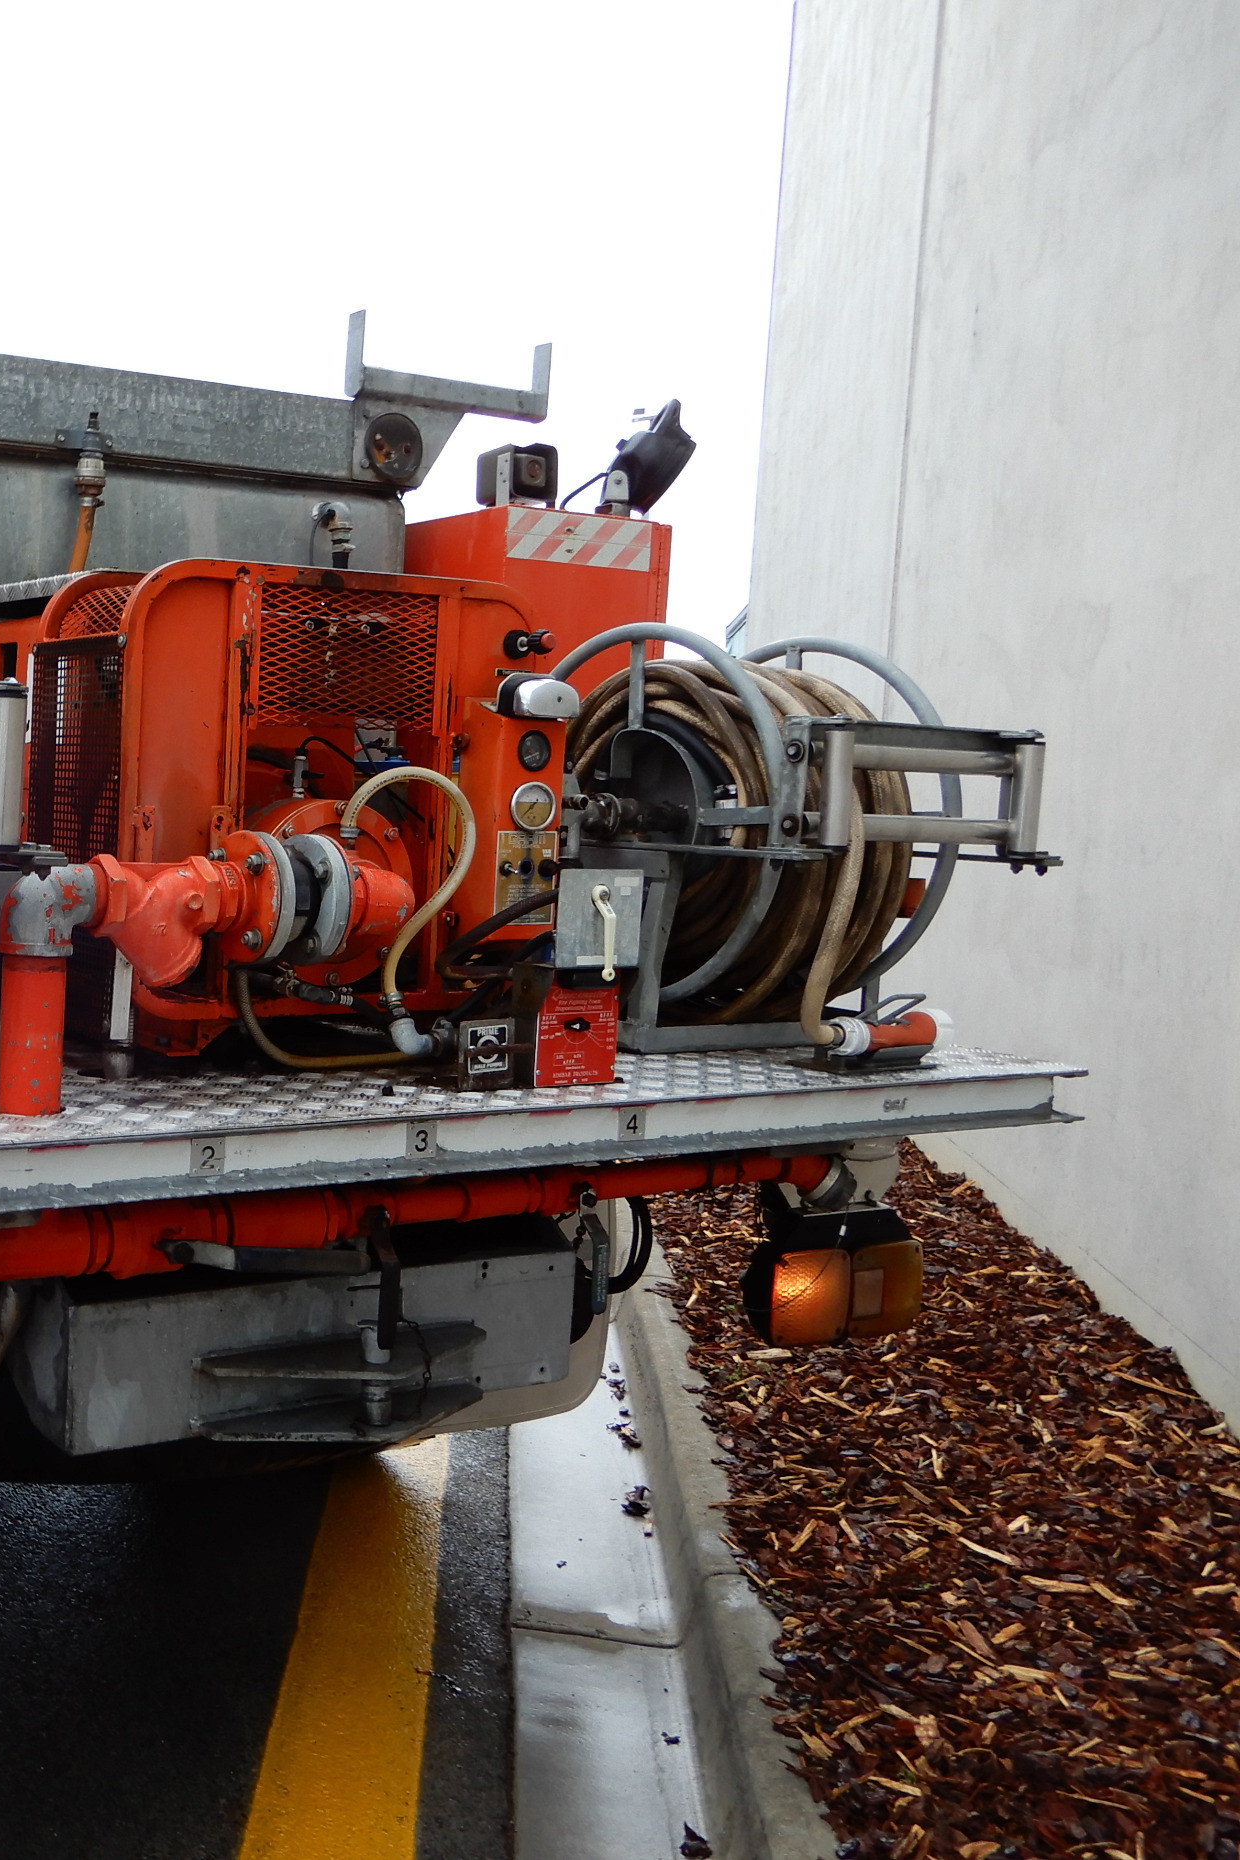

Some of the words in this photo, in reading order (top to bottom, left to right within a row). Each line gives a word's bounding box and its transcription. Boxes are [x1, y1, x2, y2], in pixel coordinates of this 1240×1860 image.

[477, 1027, 499, 1036] PRIME
[626, 1114, 638, 1135] 4
[414, 1129, 429, 1153] 3
[200, 1145, 216, 1169] 2
